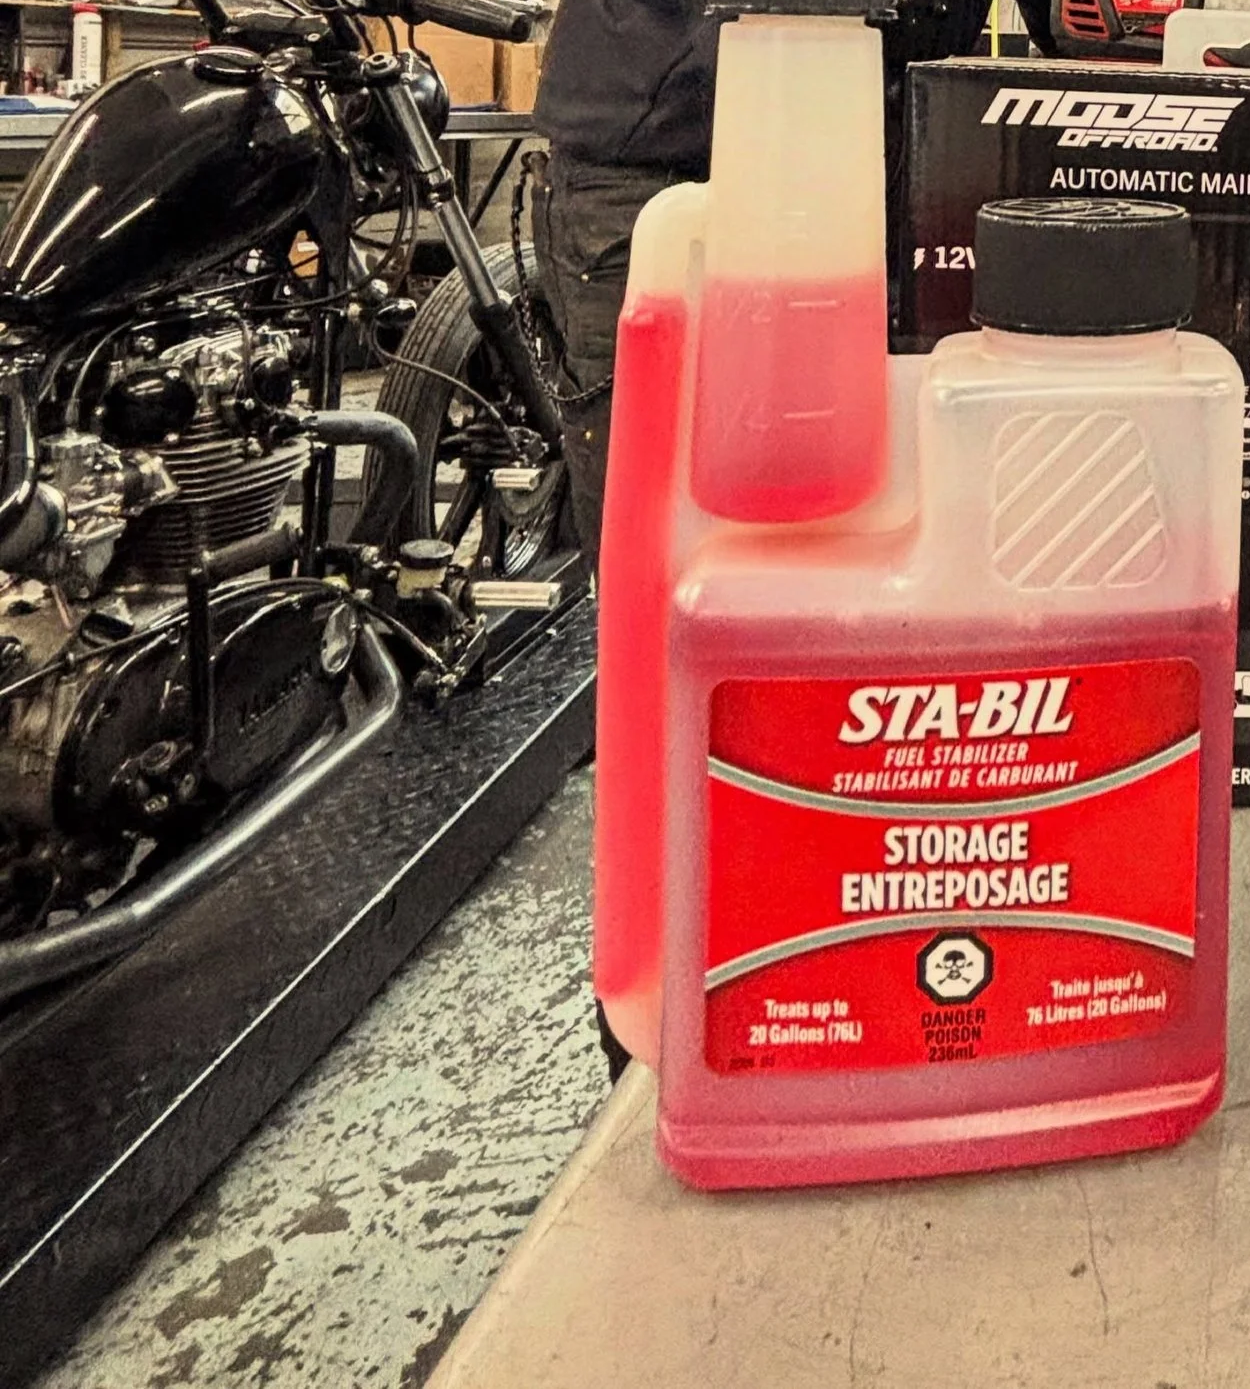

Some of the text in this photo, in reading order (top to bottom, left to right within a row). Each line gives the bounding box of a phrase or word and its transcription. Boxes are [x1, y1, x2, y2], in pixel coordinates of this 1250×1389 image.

[981, 88, 1245, 132] MOOSE
[1051, 167, 1194, 193] AUTOMATIC
[838, 677, 1074, 743] STA-BIL
[884, 742, 1029, 768] FUEL STABILIZER
[832, 761, 1079, 793] STABILISANT DE CARBURANT
[883, 821, 1029, 865] STORAGE
[841, 862, 1069, 912] ENTREPOSAGE
[1050, 978, 1091, 1000] Traite
[764, 998, 848, 1022] Treats up to
[920, 1009, 986, 1028] DANGER
[1027, 989, 1166, 1026] 76 Litres (20 Gallons)
[749, 1022, 862, 1045] 20 Gallons (76L)
[925, 1026, 982, 1045] POISON
[928, 1045, 977, 1063] 236mL
